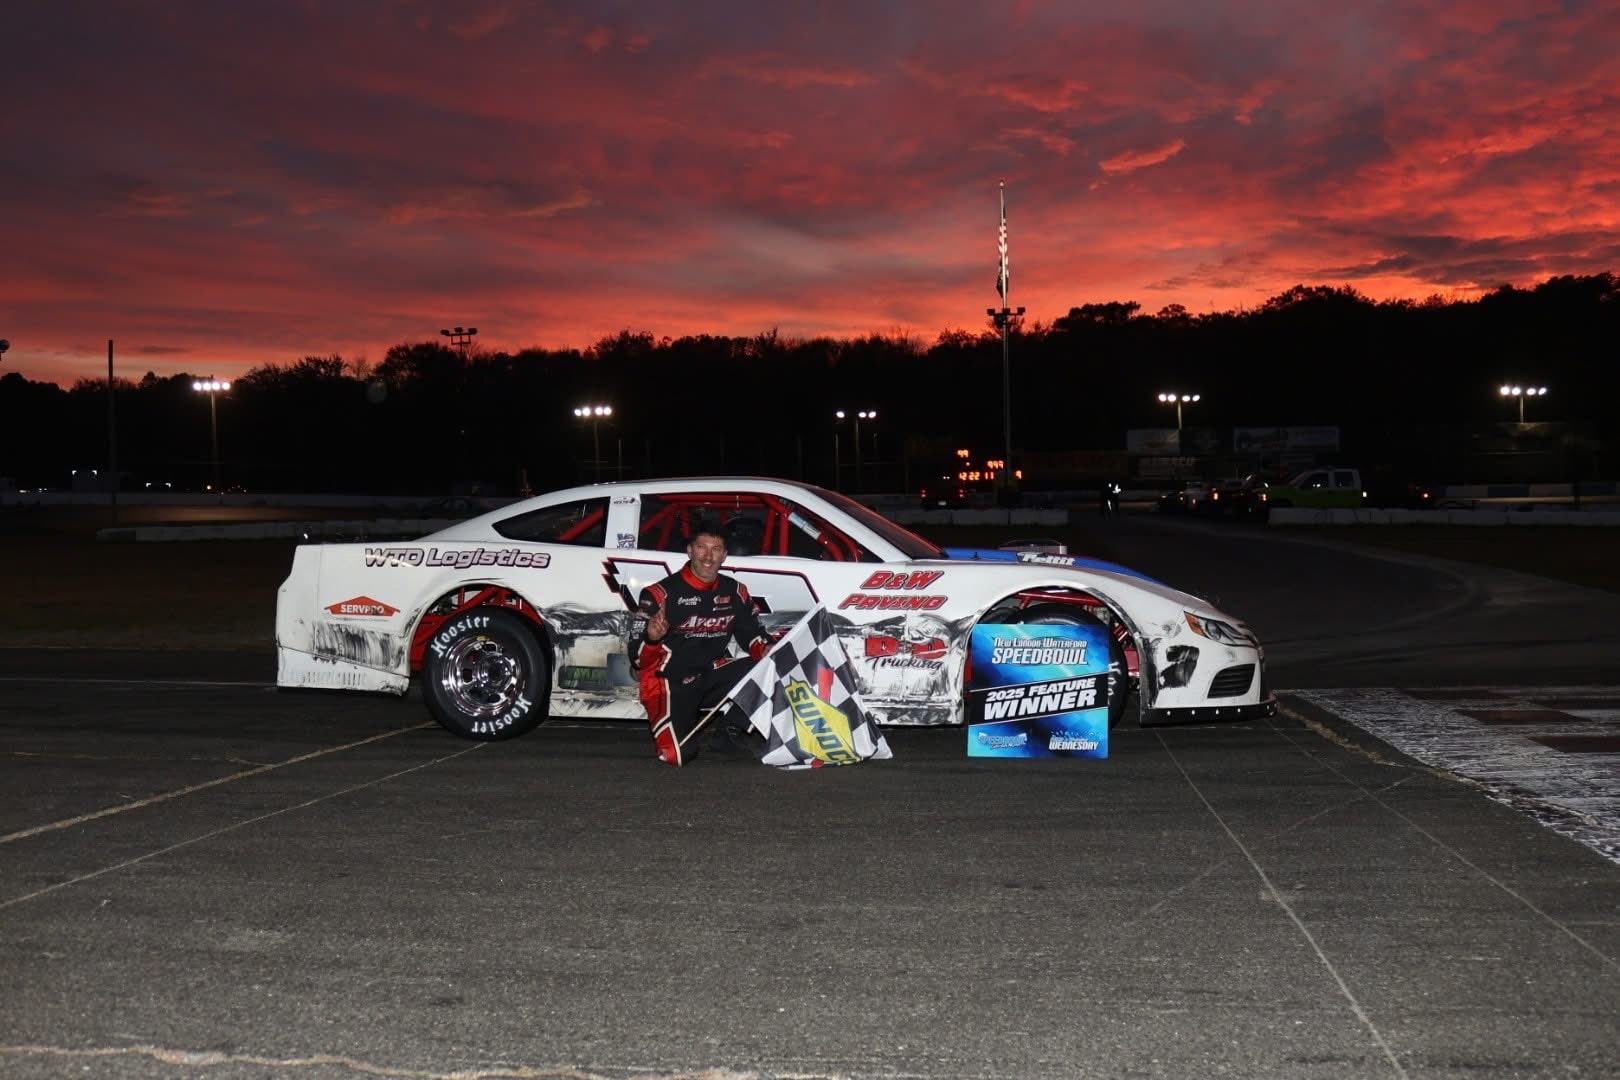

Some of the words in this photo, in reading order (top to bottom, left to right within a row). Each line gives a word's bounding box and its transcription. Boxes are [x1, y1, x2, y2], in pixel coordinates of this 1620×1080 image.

[365, 548, 424, 567] WTD
[426, 548, 551, 569] Logistics
[860, 570, 944, 590] B&W
[838, 593, 948, 610] PAVING
[680, 615, 736, 629] Avery
[430, 615, 490, 658] Hoosier
[865, 656, 944, 671] Trucking
[992, 648, 1088, 665] SPEEDBOWL
[986, 687, 1026, 702] 2025
[1028, 678, 1097, 697] FEATURE
[471, 693, 533, 736] Hoosier
[984, 689, 1097, 721] WINNER
[1049, 741, 1099, 750] WEDNESDAY
